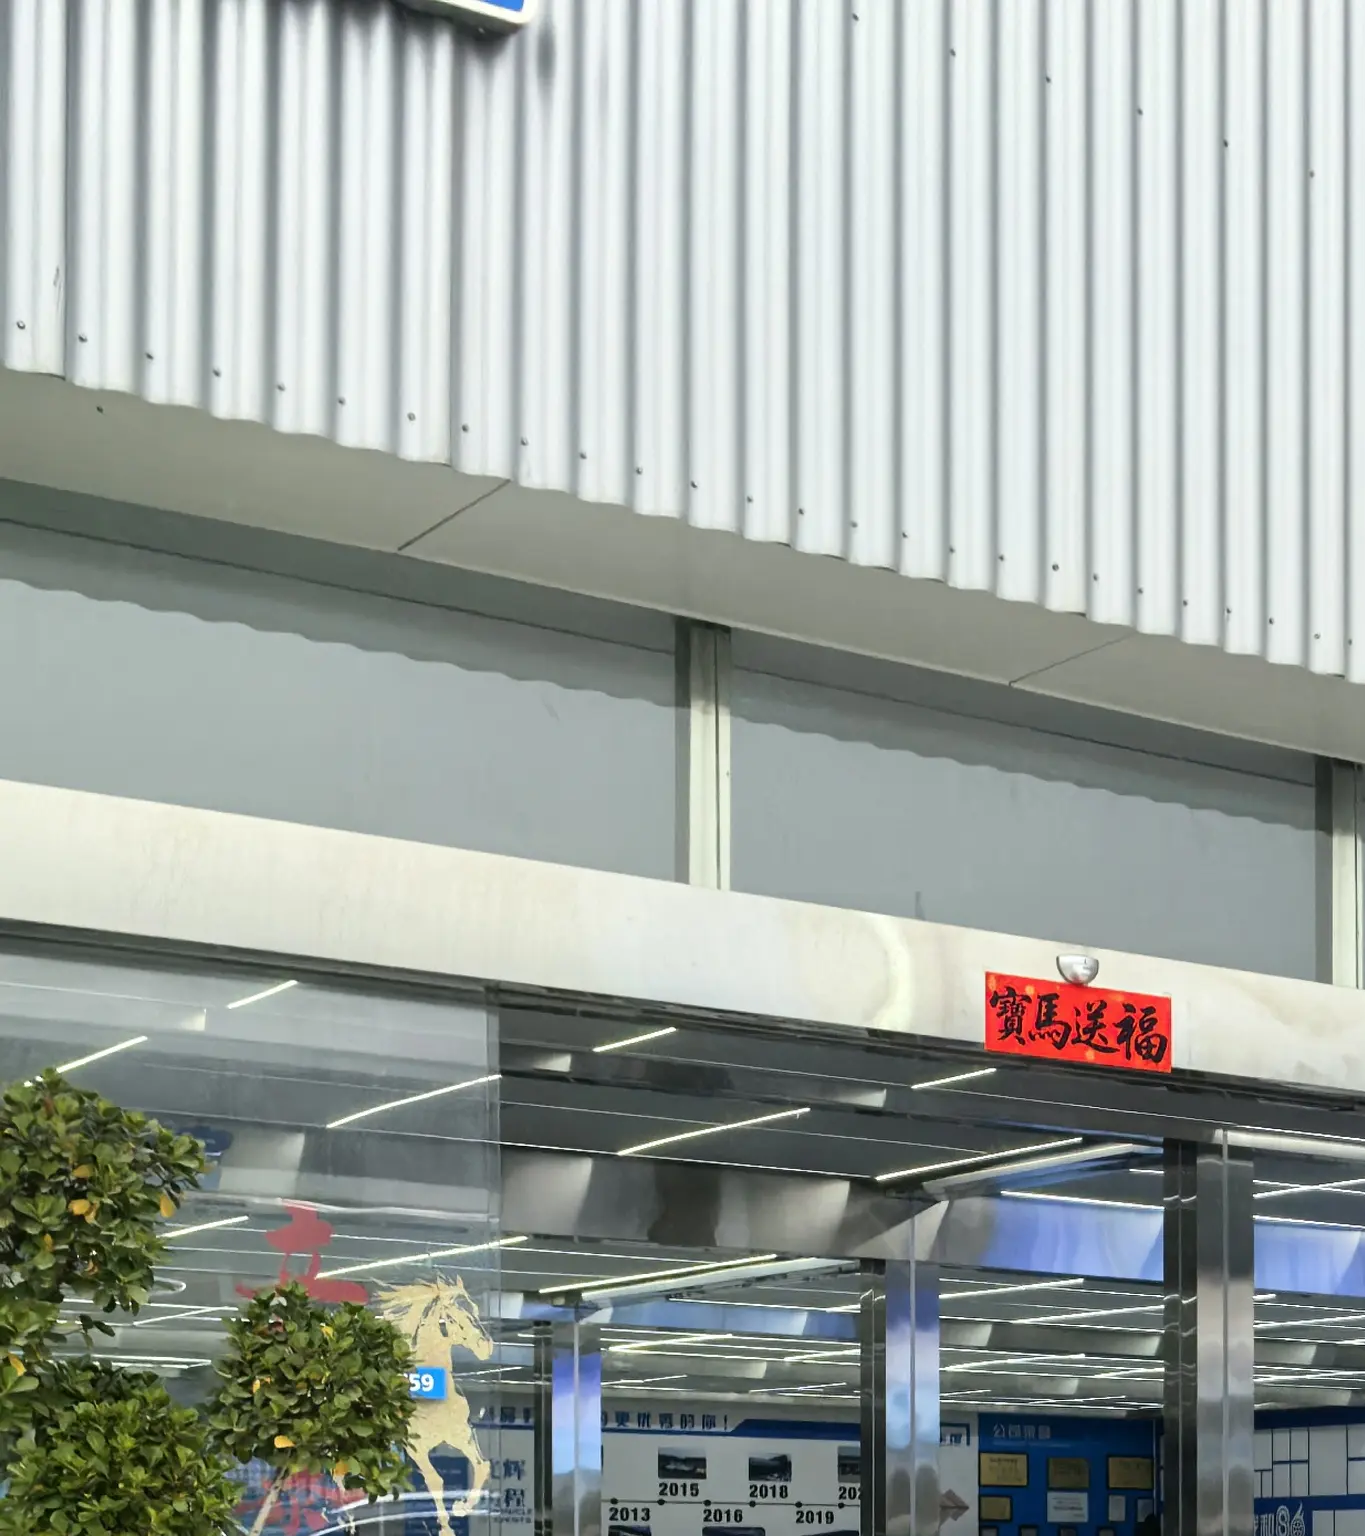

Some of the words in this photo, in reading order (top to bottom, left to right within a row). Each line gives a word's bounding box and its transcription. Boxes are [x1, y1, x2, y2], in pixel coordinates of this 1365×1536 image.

[658, 1482, 700, 1498] 2015
[748, 1484, 789, 1500] 2018
[608, 1506, 651, 1522] 2013
[703, 1508, 744, 1524] 2016
[795, 1509, 835, 1525] 2019
